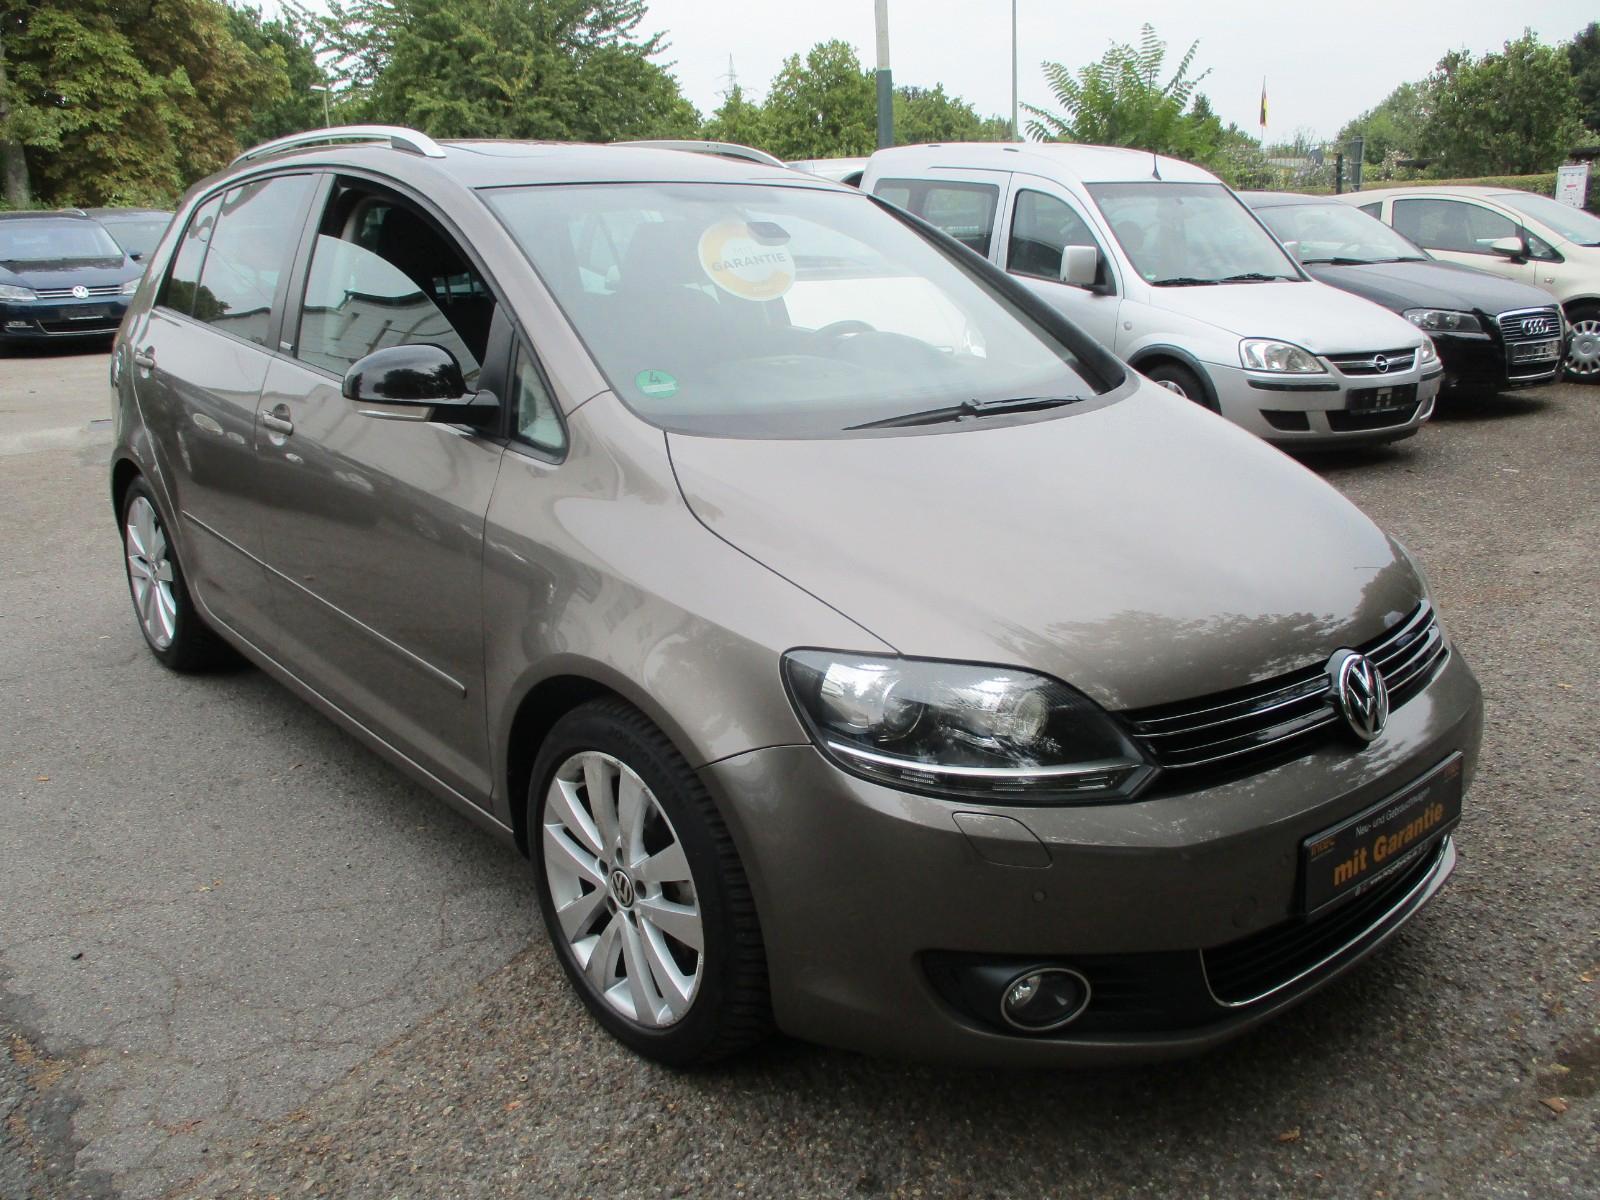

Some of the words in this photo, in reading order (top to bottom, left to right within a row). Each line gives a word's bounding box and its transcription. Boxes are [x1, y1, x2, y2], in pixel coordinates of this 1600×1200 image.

[711, 252, 787, 272] GARANTIE
[649, 369, 661, 383] 4
[1340, 654, 1389, 740] VW
[1373, 814, 1386, 829] und
[1333, 847, 1367, 886] mit
[1373, 803, 1444, 862] Garantie
